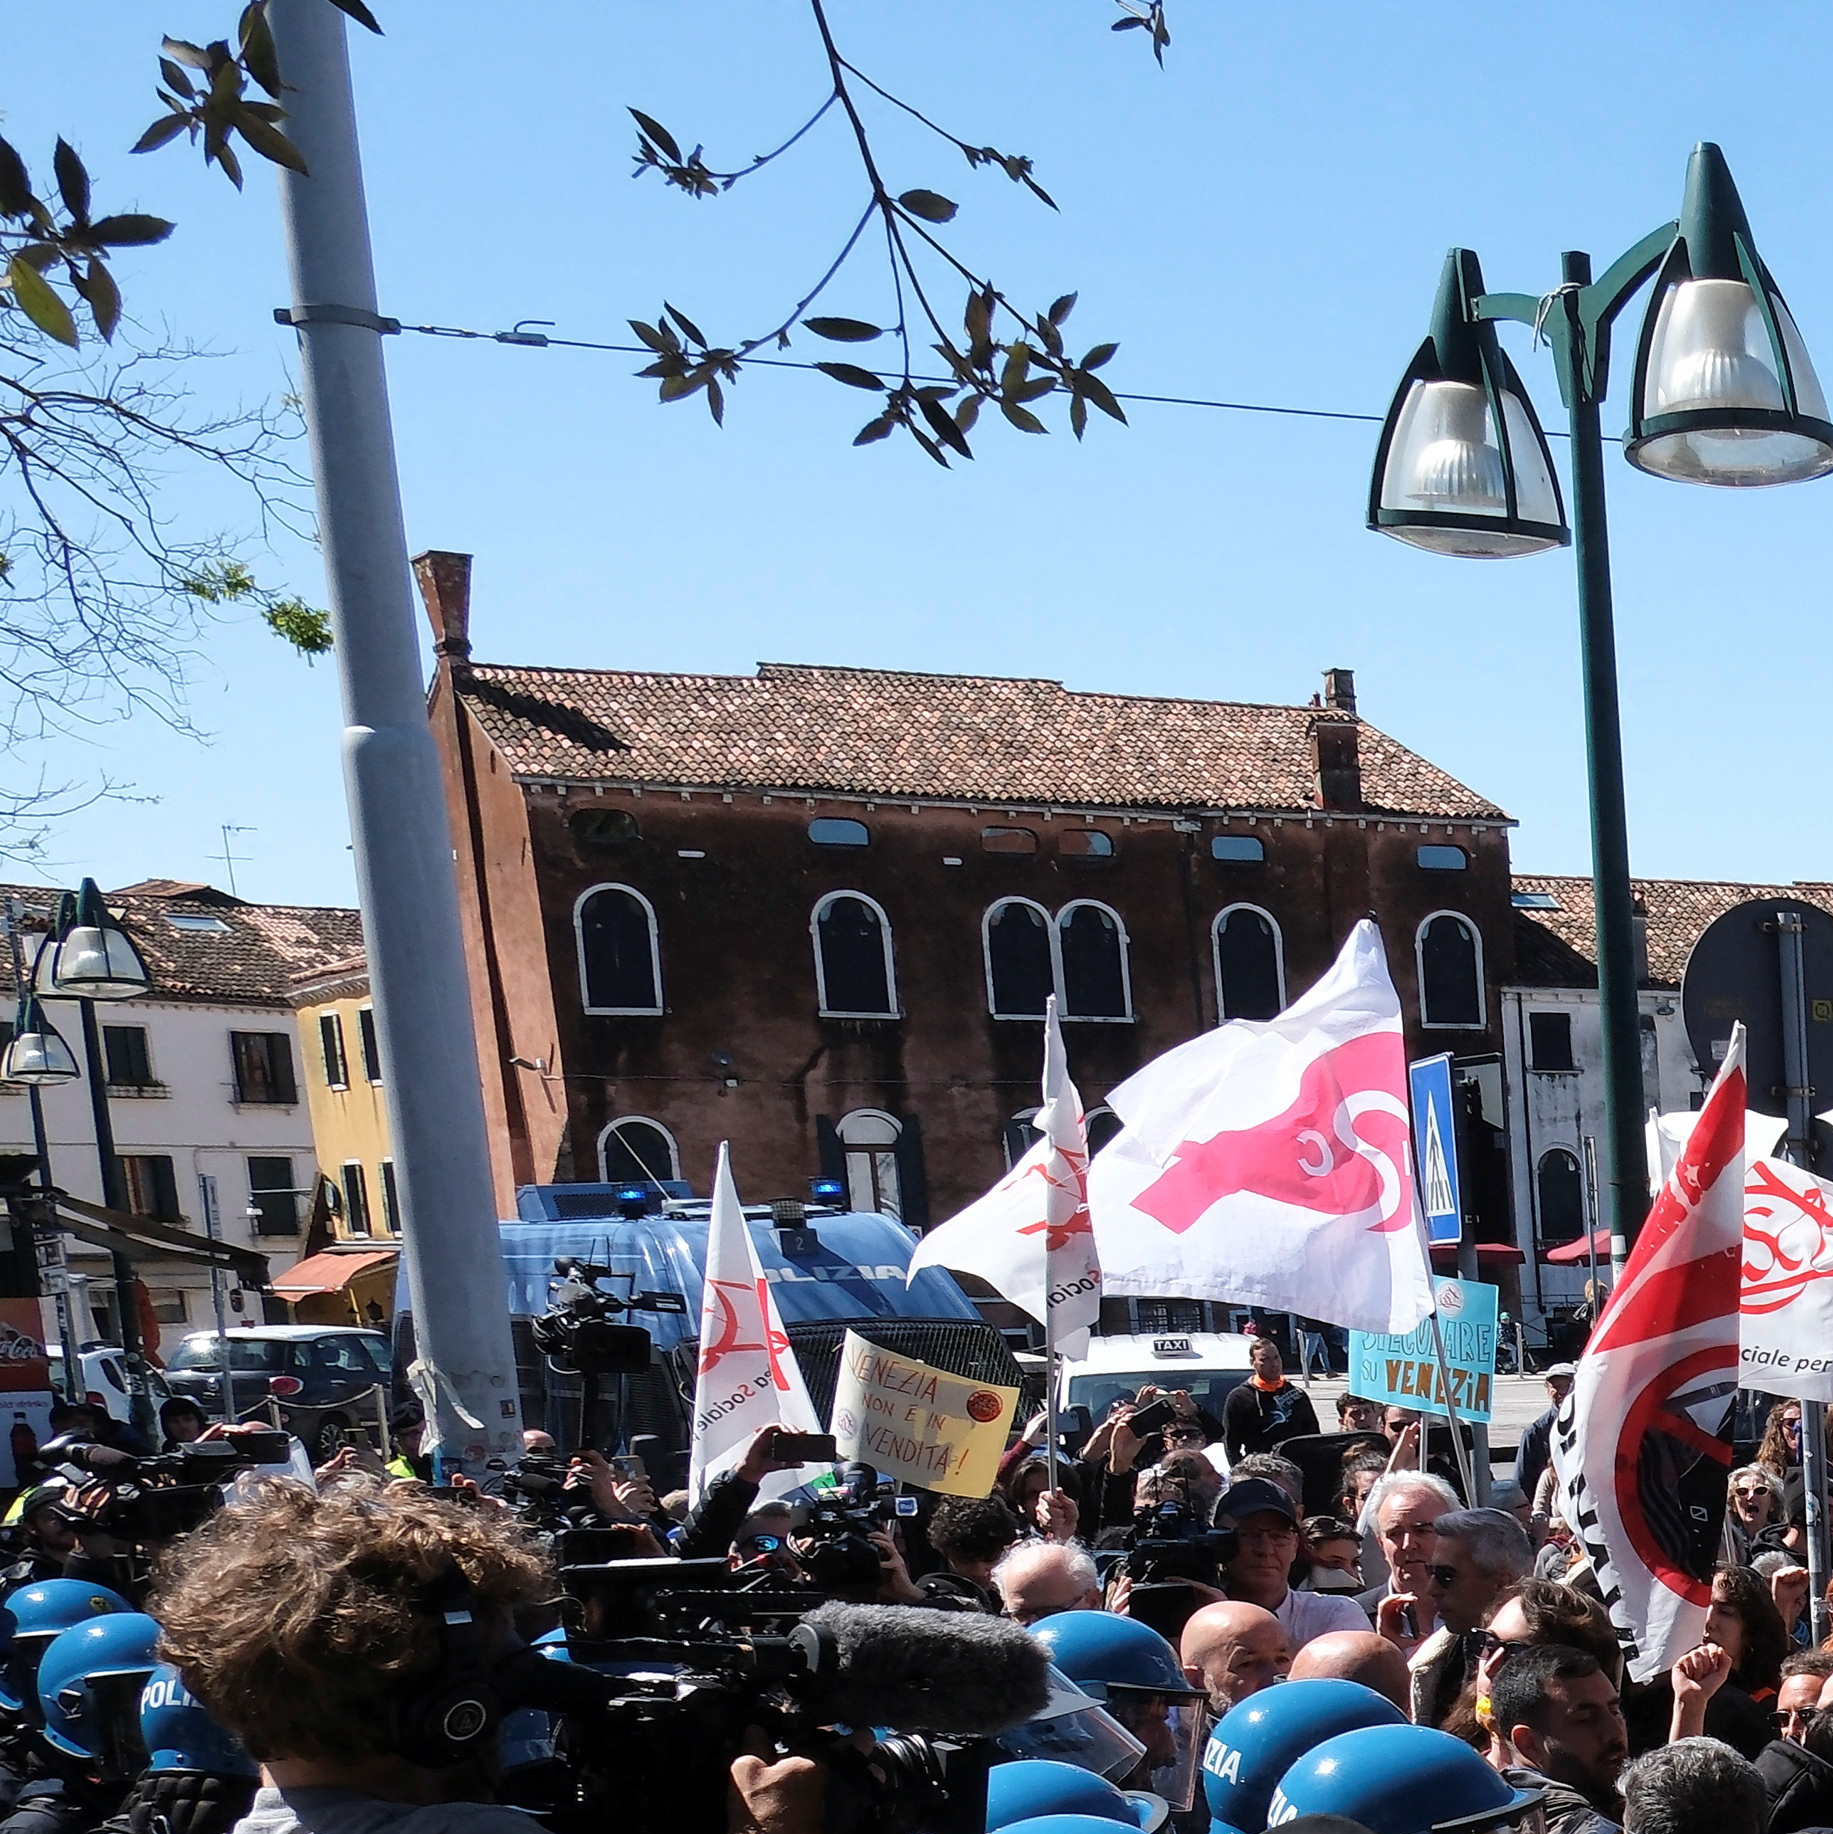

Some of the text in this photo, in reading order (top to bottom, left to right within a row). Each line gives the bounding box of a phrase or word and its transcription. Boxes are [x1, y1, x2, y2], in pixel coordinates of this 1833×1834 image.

[1155, 1339, 1190, 1352] TAXI
[1362, 1360, 1378, 1382] SU
[1794, 1356, 1833, 1375] per
[848, 1349, 939, 1405] VENEZIA
[862, 1393, 895, 1418] NON
[928, 1411, 946, 1431] IN
